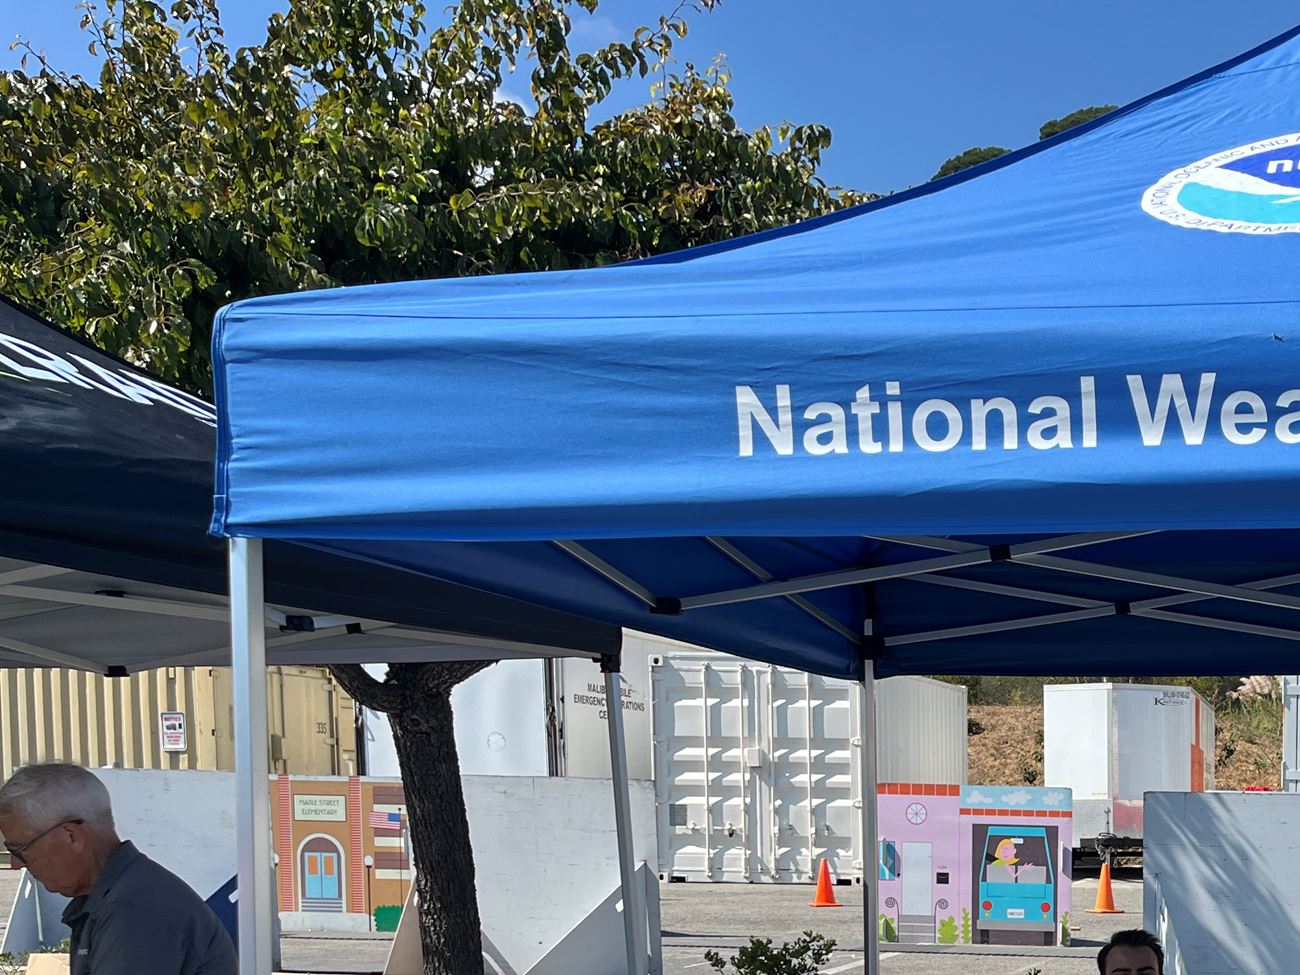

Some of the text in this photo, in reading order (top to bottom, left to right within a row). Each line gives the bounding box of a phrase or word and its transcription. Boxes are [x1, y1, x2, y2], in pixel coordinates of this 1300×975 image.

[1249, 138, 1289, 152] AND
[736, 376, 1097, 457] National
[587, 683, 606, 694] MALIB
[316, 722, 328, 734] 335
